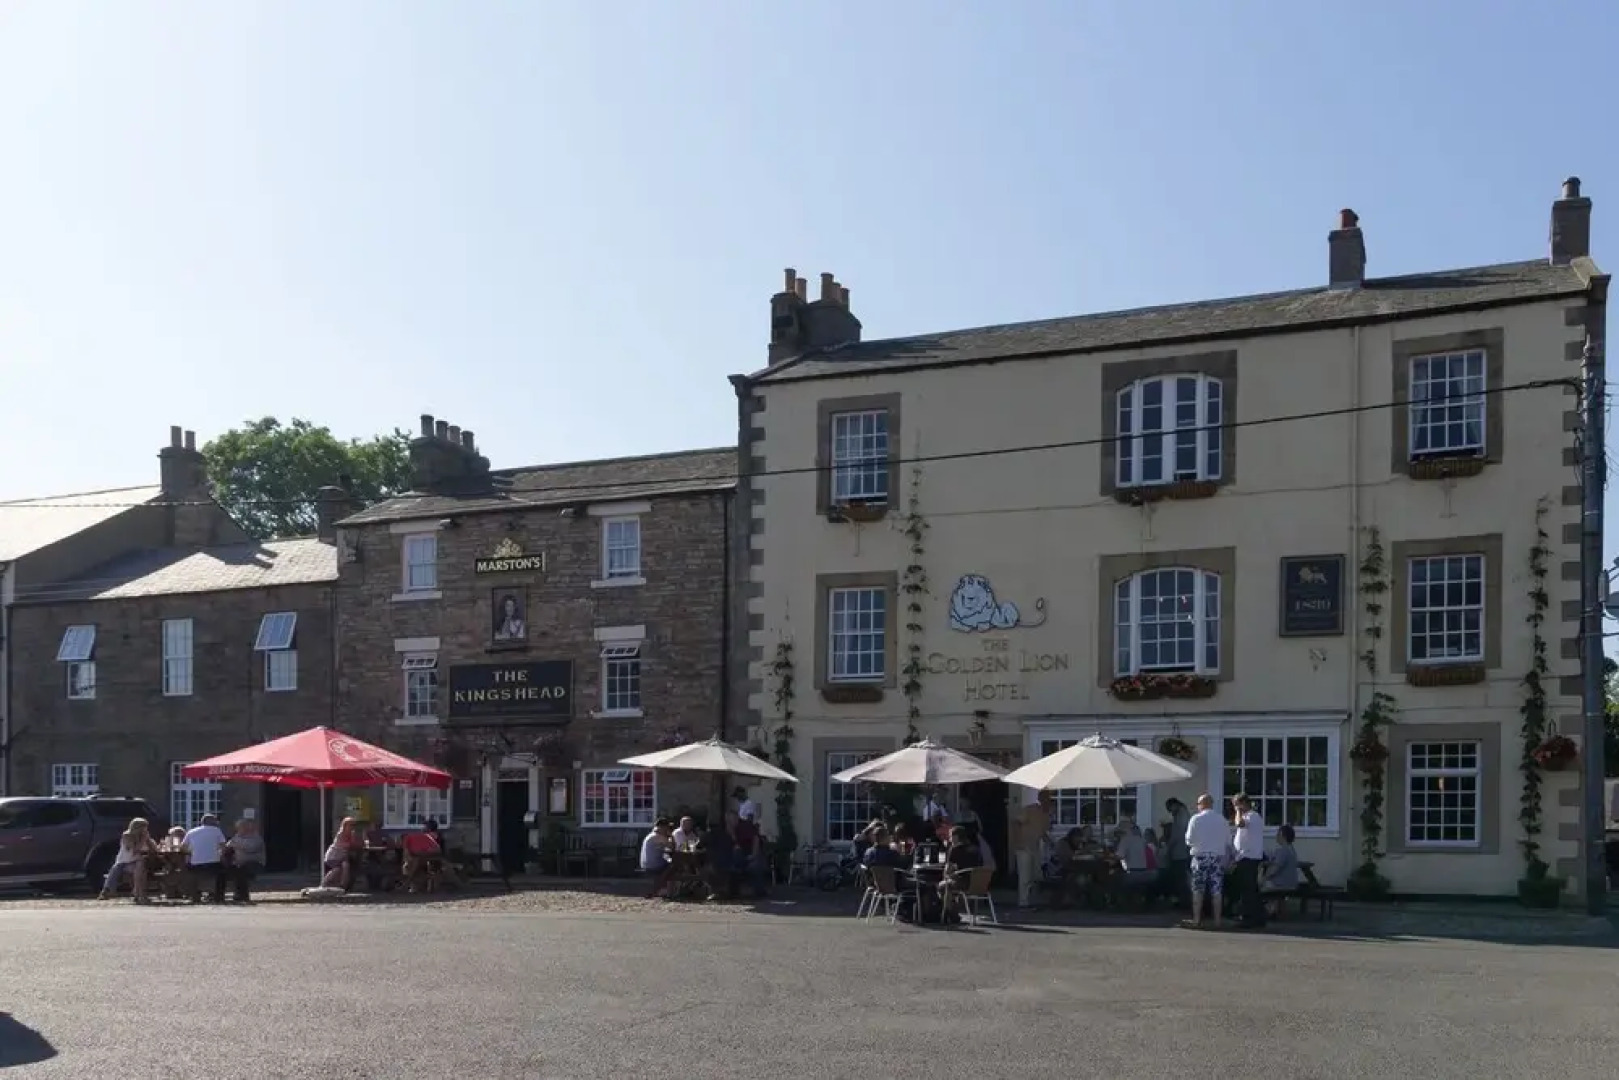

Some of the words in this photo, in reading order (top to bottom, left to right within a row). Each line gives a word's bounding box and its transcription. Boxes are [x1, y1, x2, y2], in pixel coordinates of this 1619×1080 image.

[477, 555, 541, 573] MARSTON'S
[982, 637, 1010, 651] THE
[492, 669, 529, 683] THE
[965, 679, 1030, 701] HOTEL
